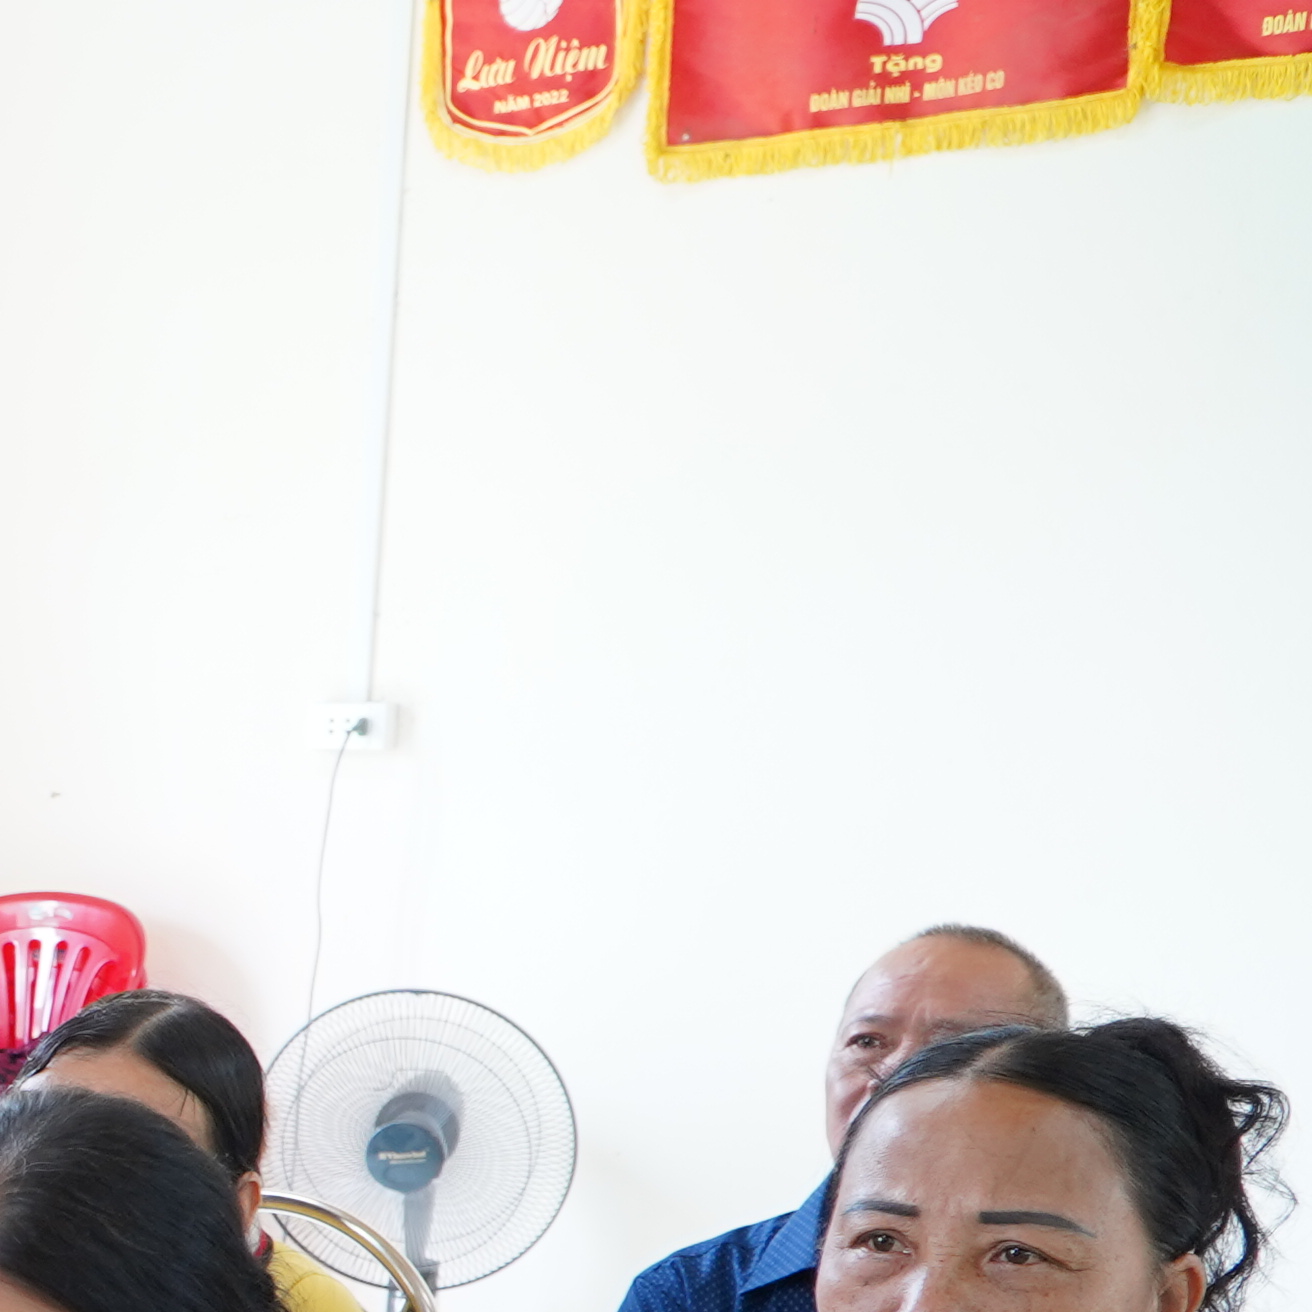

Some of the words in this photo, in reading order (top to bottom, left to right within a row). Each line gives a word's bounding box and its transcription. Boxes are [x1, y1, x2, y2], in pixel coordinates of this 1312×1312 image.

[523, 34, 609, 82] Niệm
[870, 53, 944, 77] Tặng
[493, 94, 531, 114] NĂM
[532, 87, 570, 107] 2022
